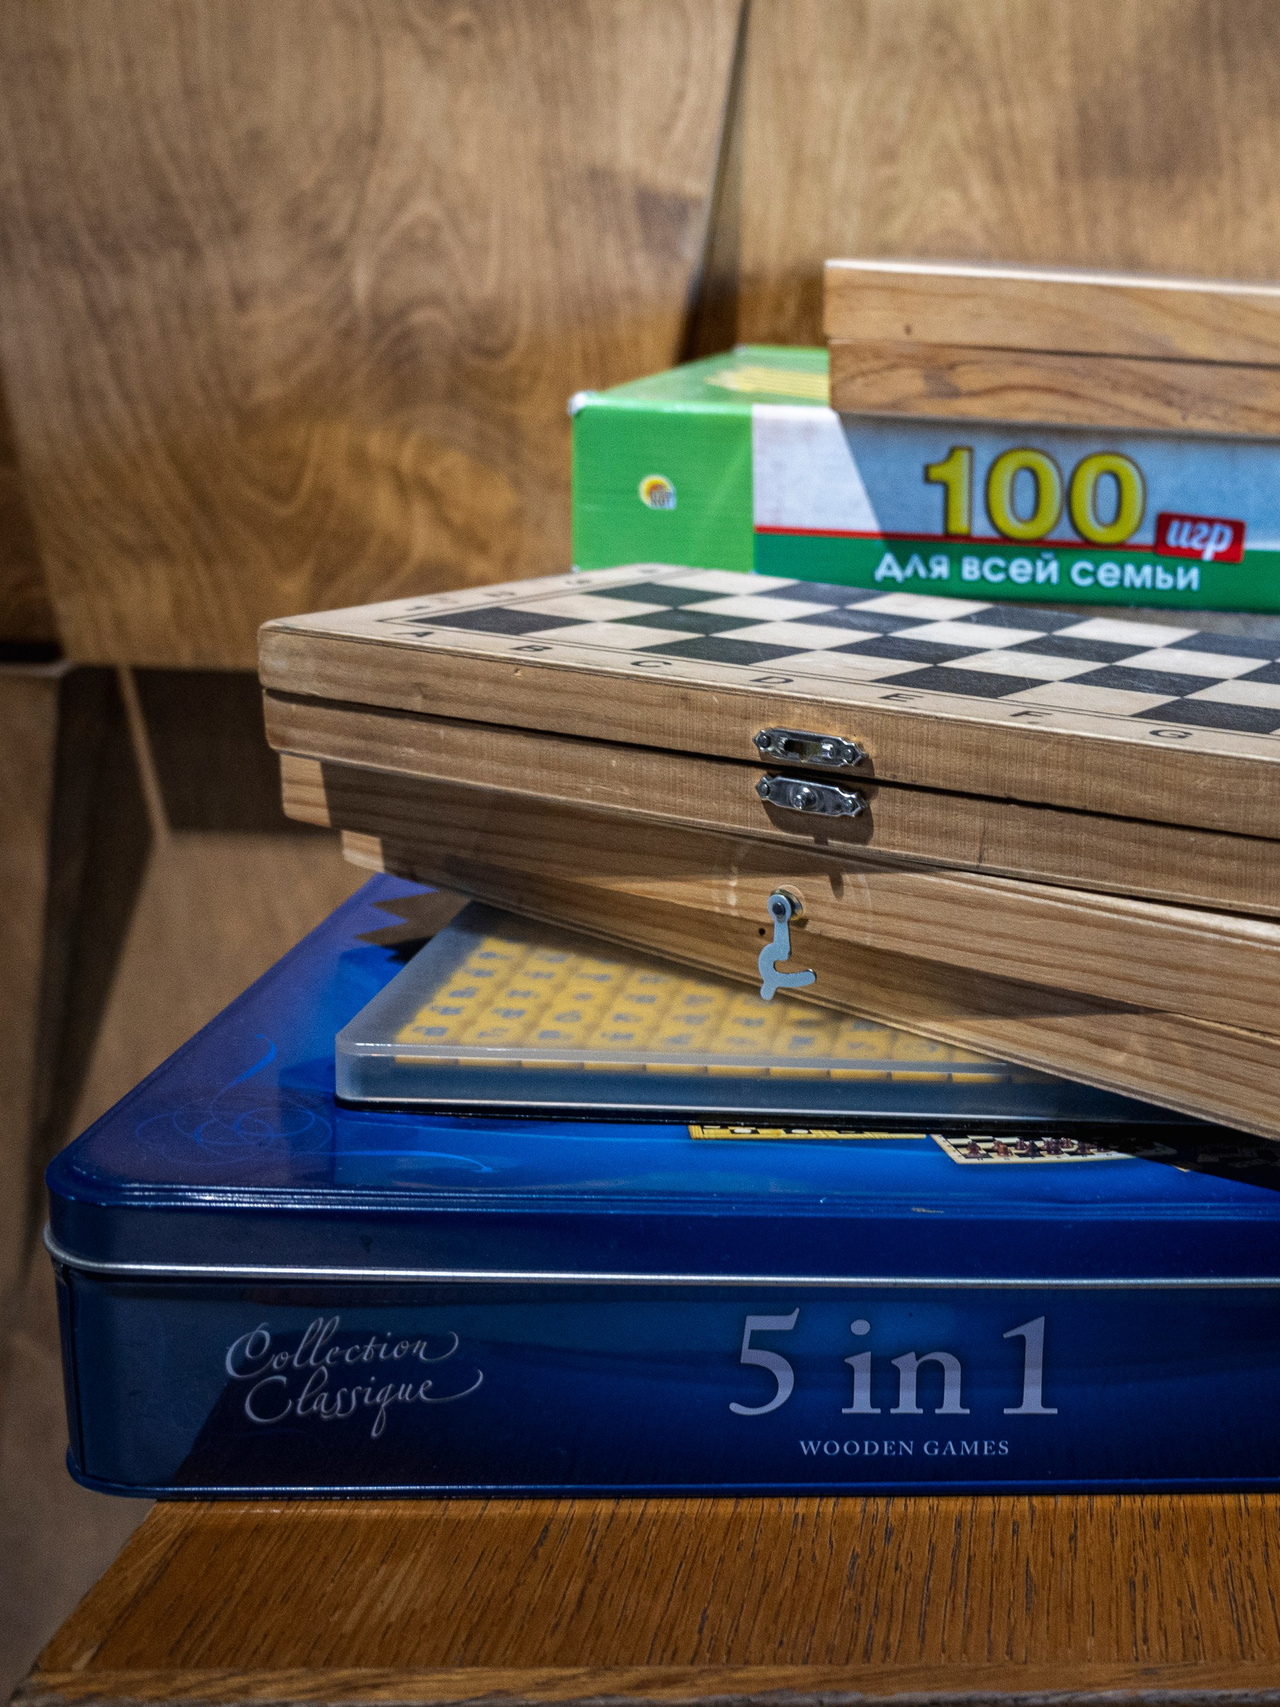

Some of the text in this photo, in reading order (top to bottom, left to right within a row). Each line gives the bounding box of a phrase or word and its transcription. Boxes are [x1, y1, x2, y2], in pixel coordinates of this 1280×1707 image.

[924, 446, 1147, 546] 100
[960, 552, 1060, 585] всей
[1070, 560, 1200, 592] семьи
[1165, 519, 1234, 562] игр
[225, 1315, 459, 1379] Collection
[729, 1307, 1058, 1416] 5 in 1
[245, 1366, 484, 1439] Classique
[799, 1439, 1010, 1457] WOODEN GAMES
